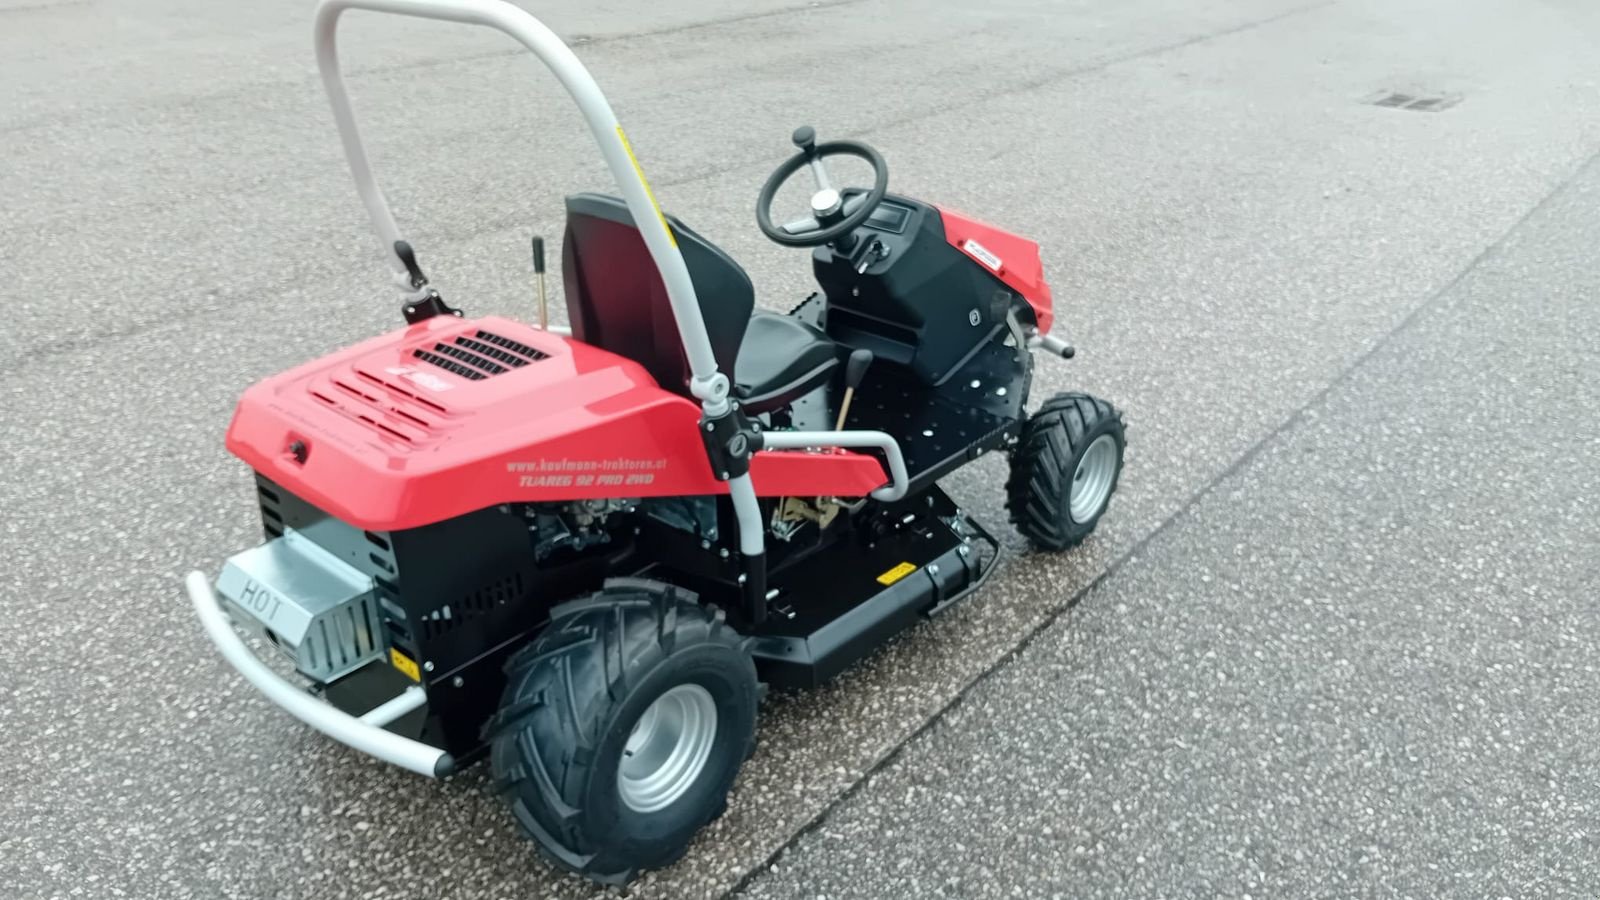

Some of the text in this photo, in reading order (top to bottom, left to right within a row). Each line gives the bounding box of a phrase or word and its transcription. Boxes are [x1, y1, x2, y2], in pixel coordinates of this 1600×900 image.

[507, 458, 667, 473] www.kaufmann-traktoren.at
[519, 473, 655, 487] TUAREG 92 PRO 2WD
[240, 579, 281, 620] HOT
